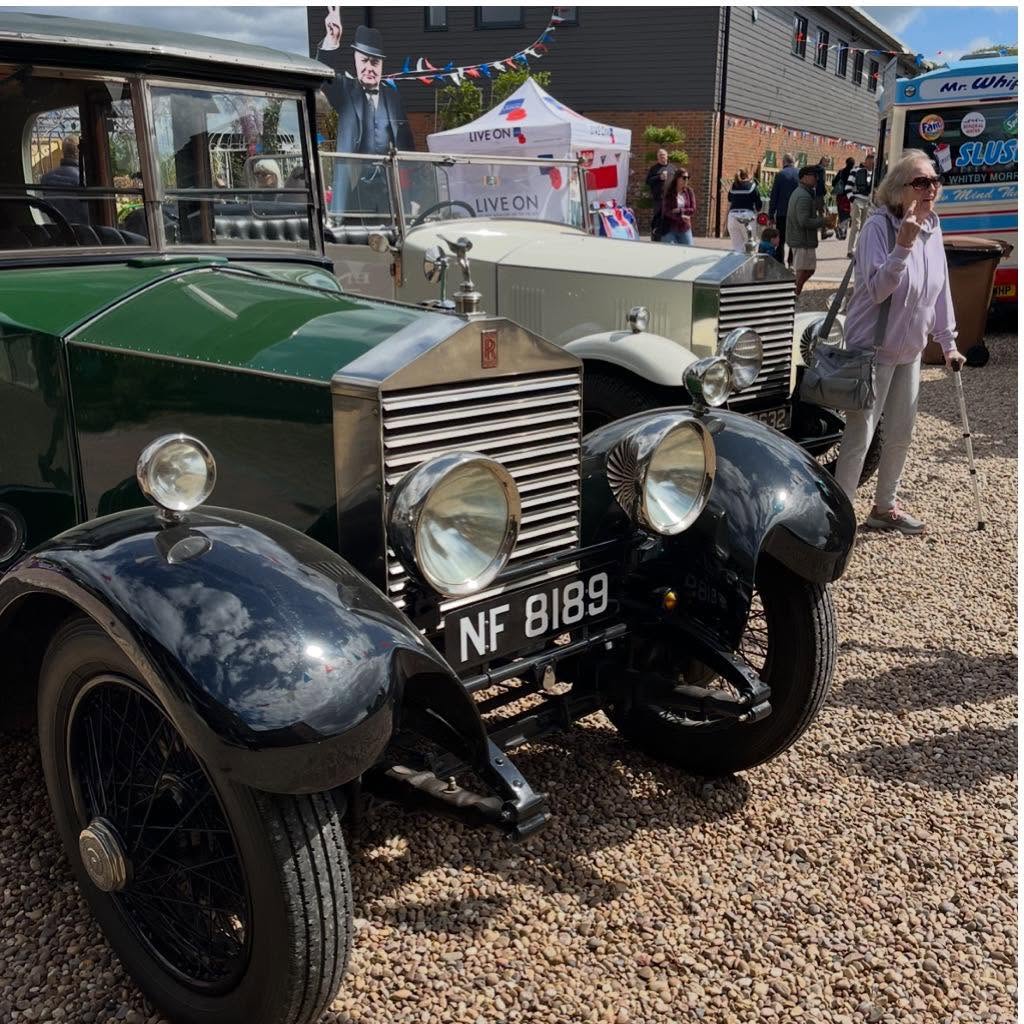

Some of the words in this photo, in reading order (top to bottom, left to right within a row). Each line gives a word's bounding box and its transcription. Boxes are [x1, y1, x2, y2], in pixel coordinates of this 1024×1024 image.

[940, 81, 967, 93] Mr.
[469, 130, 491, 143] LIVE
[493, 127, 511, 141] ON
[475, 196, 509, 213] LIVE
[512, 195, 538, 212] ON
[459, 604, 510, 663] NF
[525, 572, 608, 638] 8189
